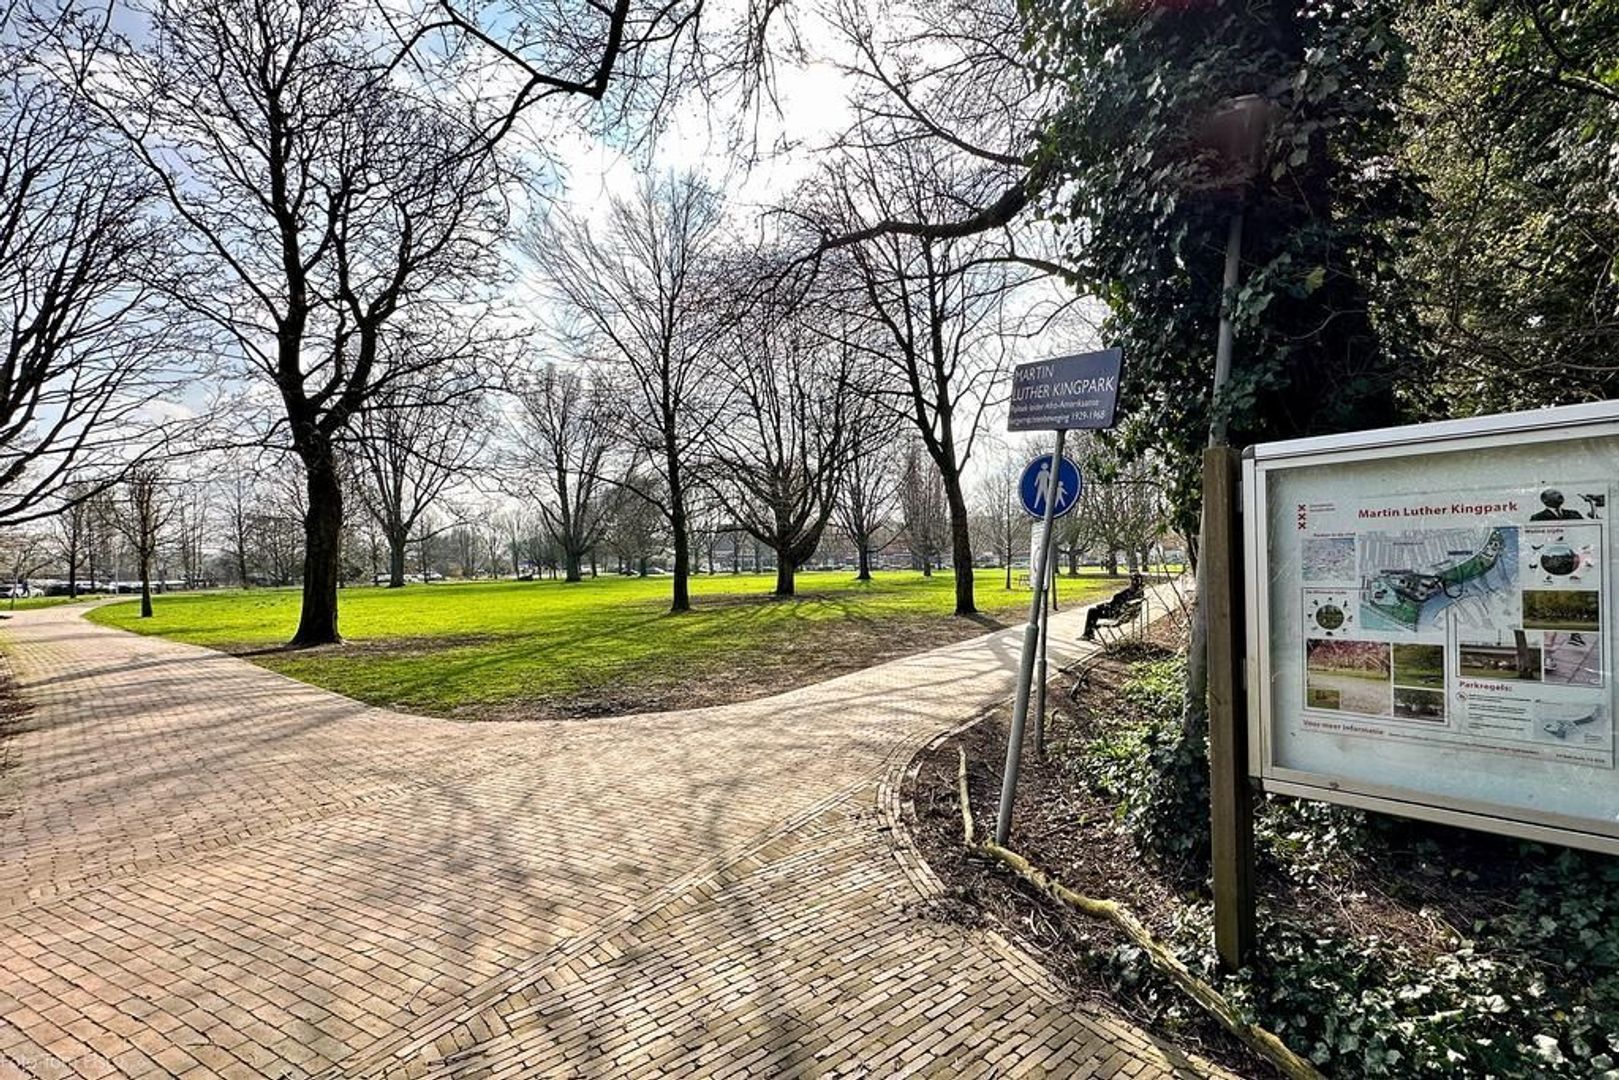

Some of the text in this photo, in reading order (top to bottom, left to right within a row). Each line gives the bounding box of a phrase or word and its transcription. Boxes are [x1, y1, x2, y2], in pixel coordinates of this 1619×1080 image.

[1014, 364, 1055, 381] MARTIN
[1012, 376, 1115, 401] LUTHER KINGPARK
[1358, 501, 1518, 518] Martin Luther Kingpark
[1322, 722, 1341, 730] meer
